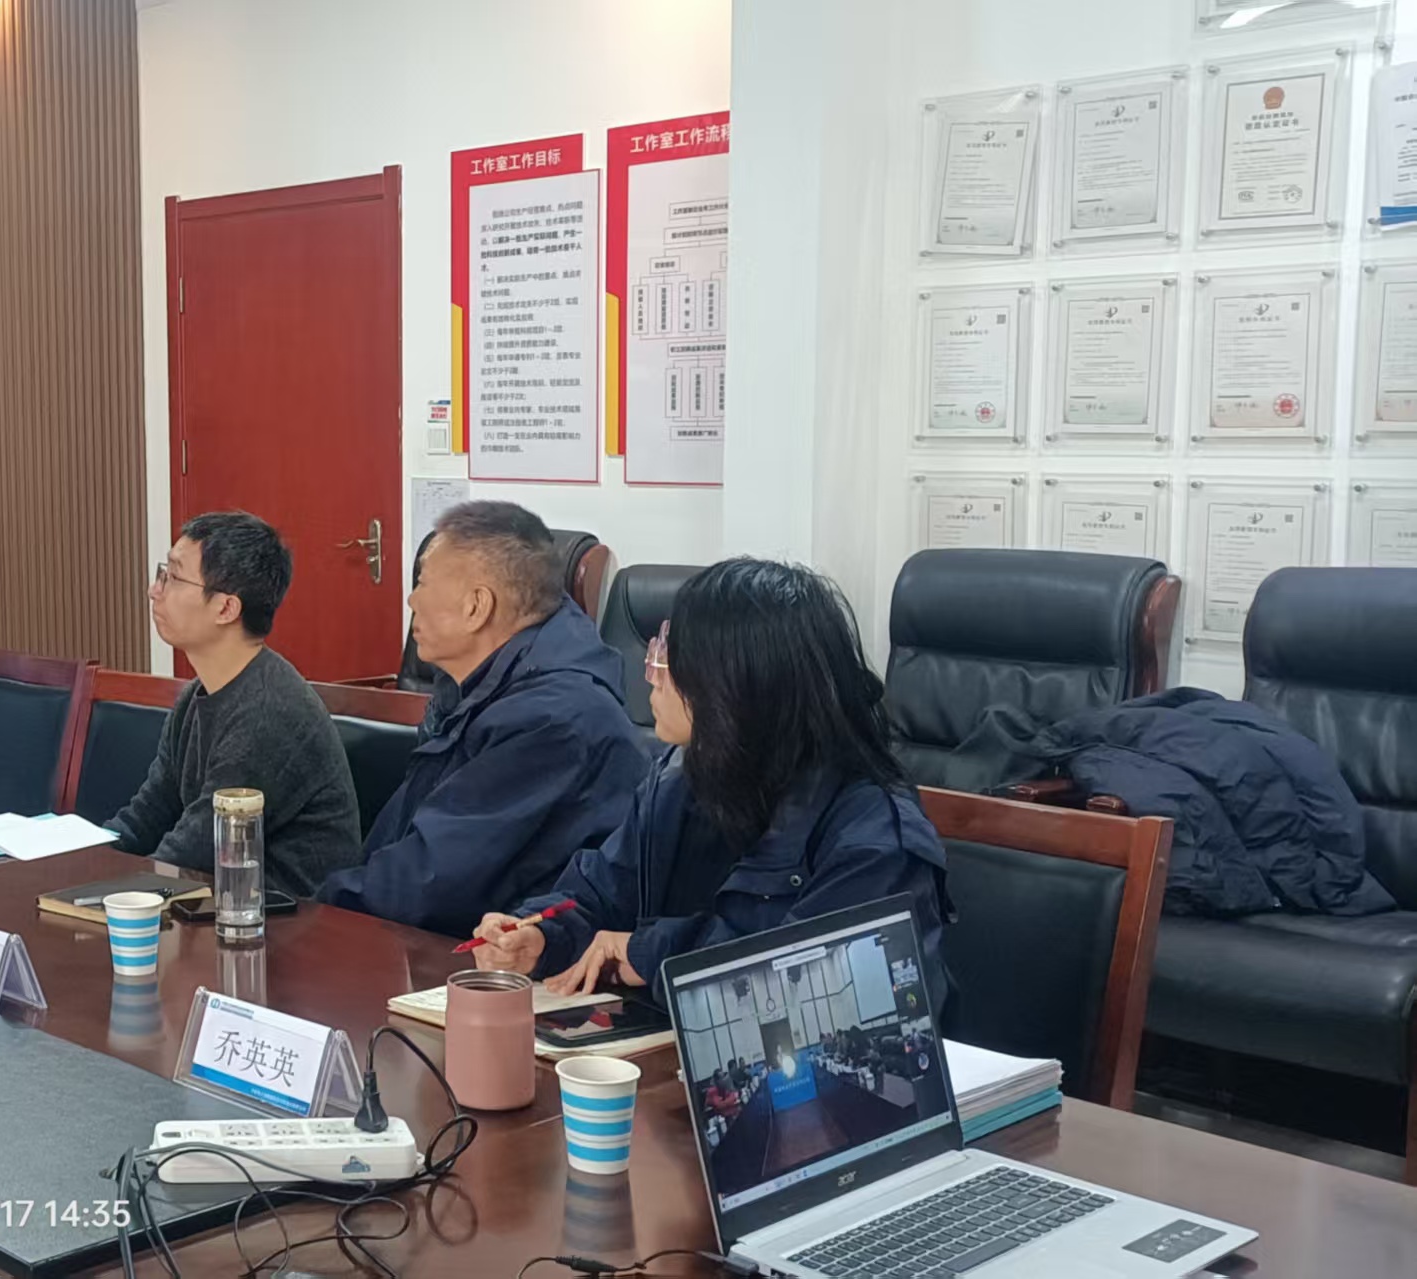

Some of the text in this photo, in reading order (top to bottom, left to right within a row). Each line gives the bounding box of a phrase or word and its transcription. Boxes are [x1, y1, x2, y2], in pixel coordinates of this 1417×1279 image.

[470, 148, 562, 175] 工作室工作目标
[213, 1030, 299, 1088] 乔英英
[837, 1170, 857, 1187] acer
